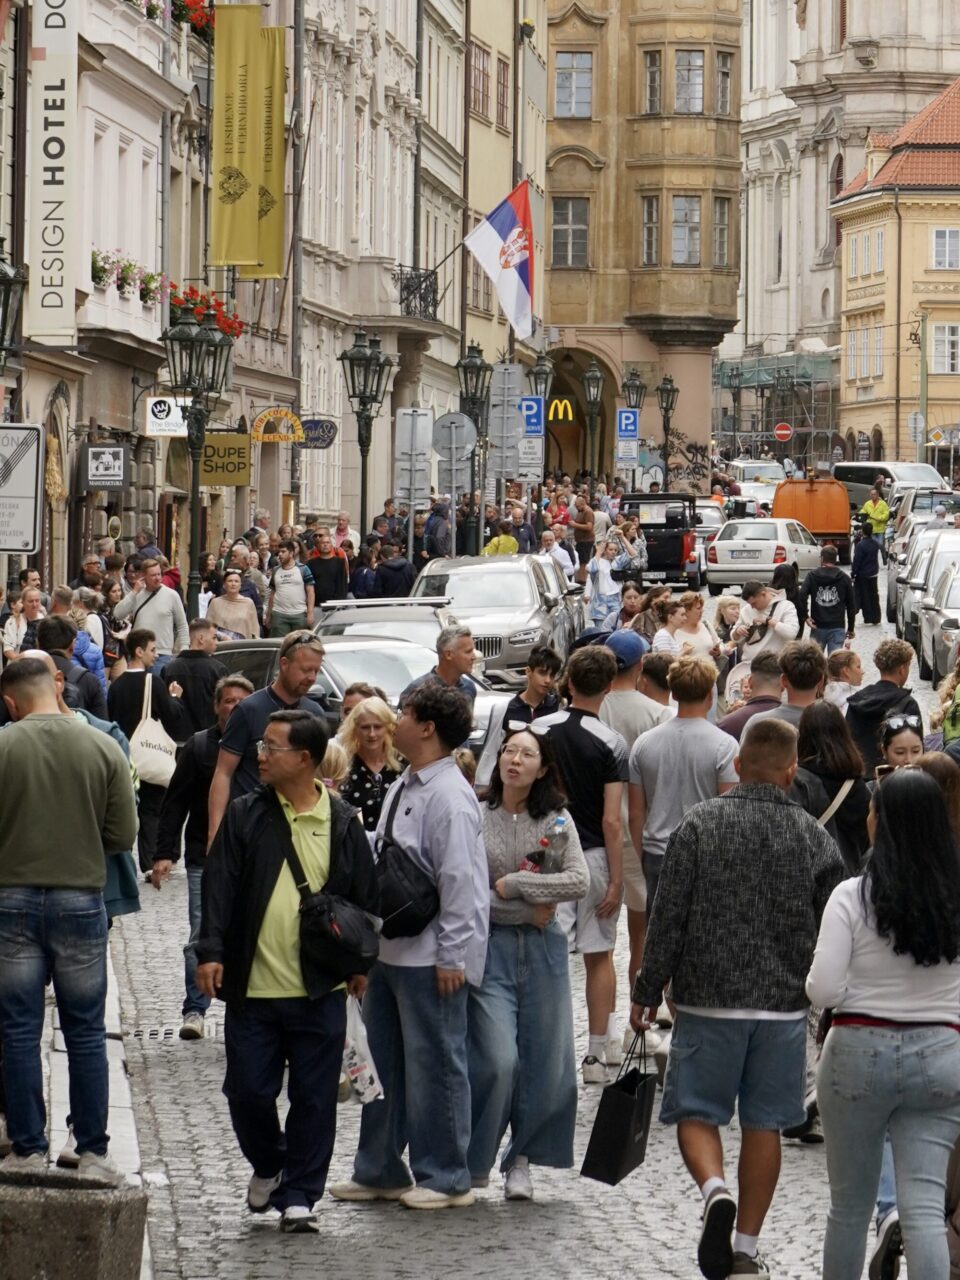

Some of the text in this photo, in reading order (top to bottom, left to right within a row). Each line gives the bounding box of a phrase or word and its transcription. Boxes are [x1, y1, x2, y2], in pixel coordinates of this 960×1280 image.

[238, 64, 248, 92] ORLA
[43, 78, 66, 185] HOTEL
[224, 92, 234, 154] RESIDENCE
[41, 200, 65, 308] DESIGN
[203, 459, 246, 474] SHOP
[204, 445, 246, 458] DUPE
